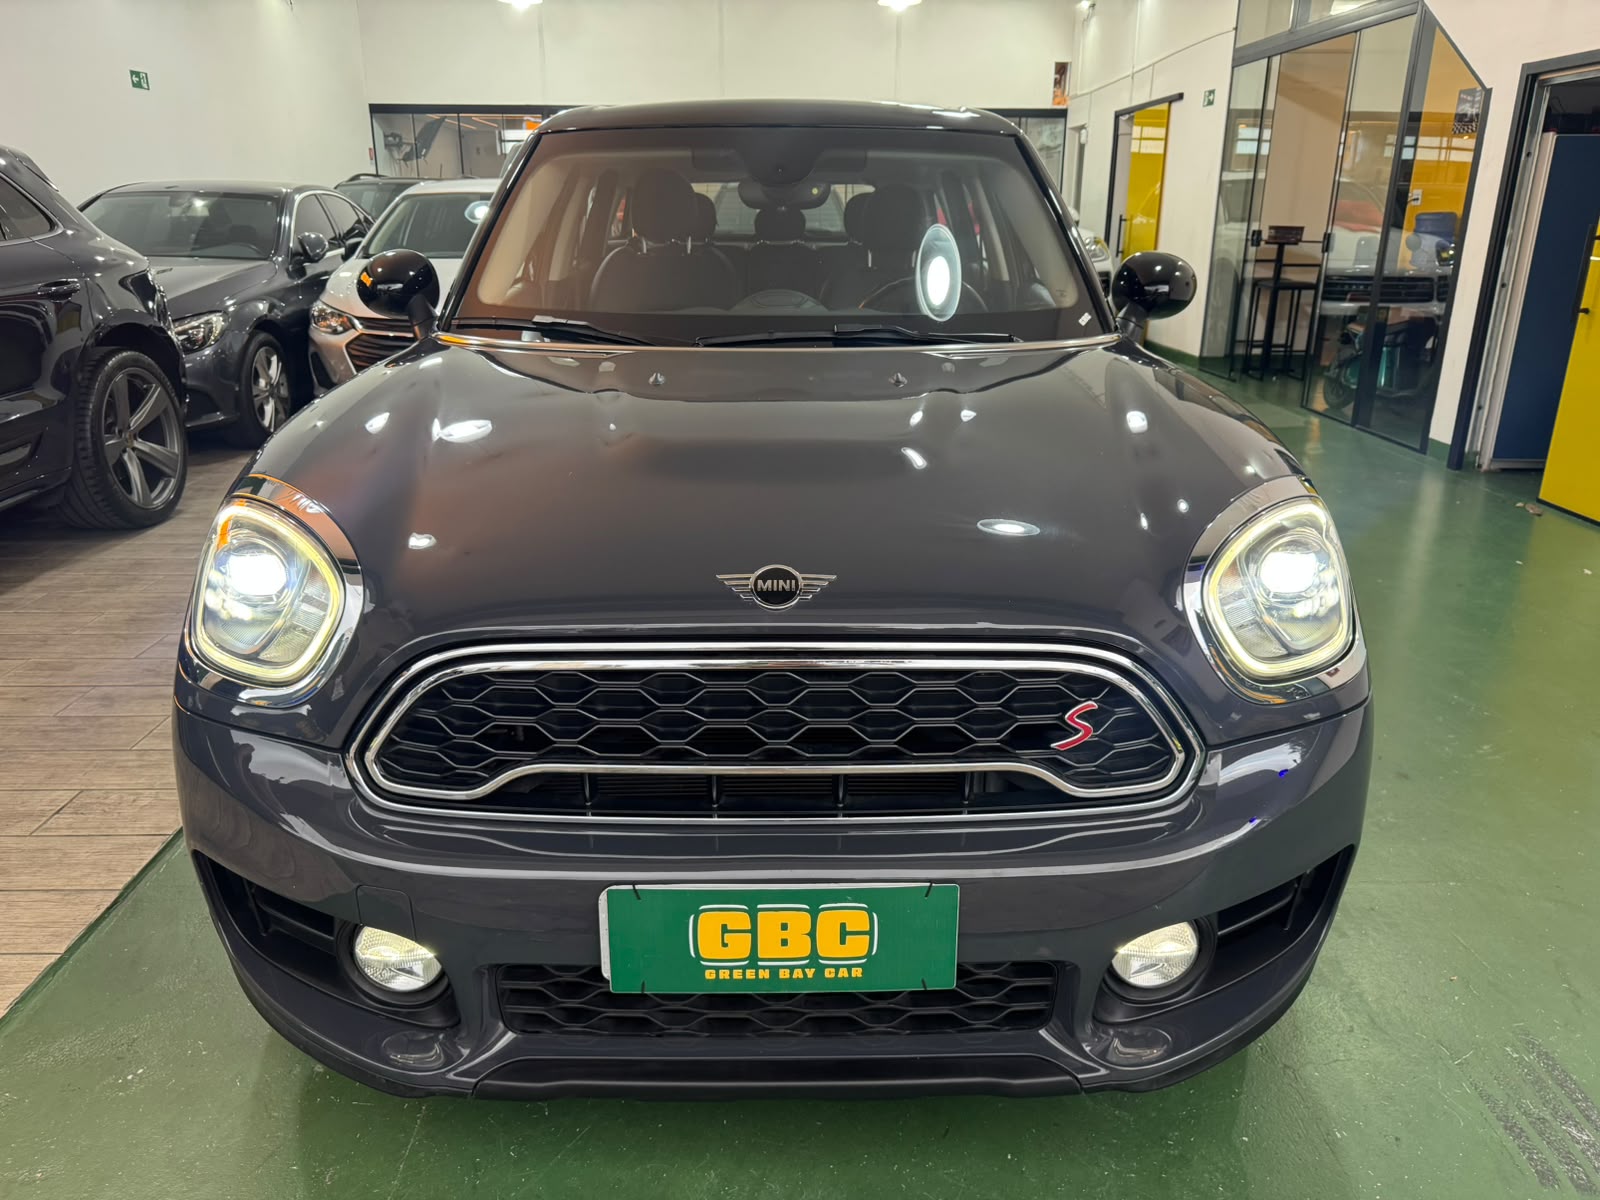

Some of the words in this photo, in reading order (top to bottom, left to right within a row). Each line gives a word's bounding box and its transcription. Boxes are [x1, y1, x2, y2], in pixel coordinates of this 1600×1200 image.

[757, 579, 796, 592] MINI
[1050, 700, 1098, 751] S
[697, 909, 870, 960] GBC
[704, 968, 770, 980] GREEN
[779, 968, 816, 979] BAY
[824, 967, 863, 978] CAR
